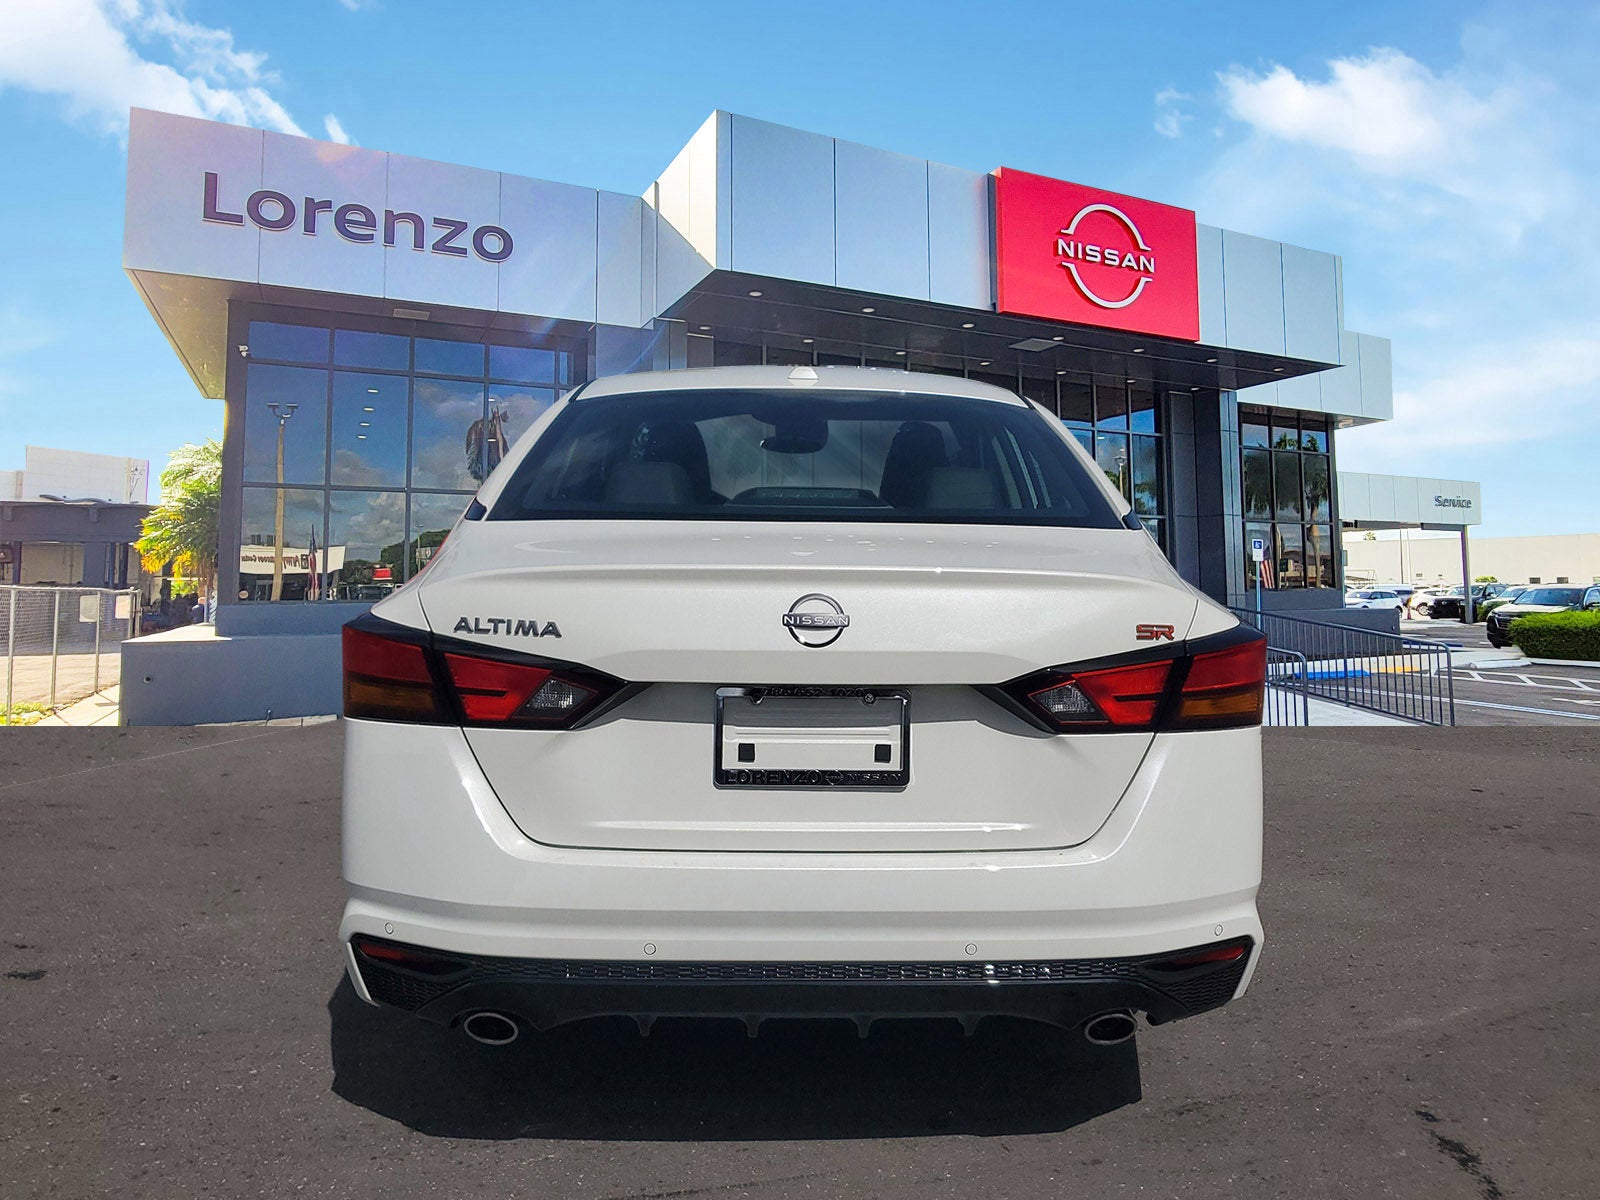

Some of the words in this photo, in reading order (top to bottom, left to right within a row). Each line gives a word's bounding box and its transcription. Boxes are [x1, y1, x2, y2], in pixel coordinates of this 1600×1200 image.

[202, 171, 514, 262] Lorenzo
[1057, 238, 1155, 273] NISSAN
[1434, 495, 1472, 509] Service
[453, 616, 562, 639] ALTIMA
[783, 616, 849, 626] NISSAN
[1135, 623, 1175, 641] SR
[725, 769, 822, 785] LORENZO
[846, 773, 901, 782] NISSAN
